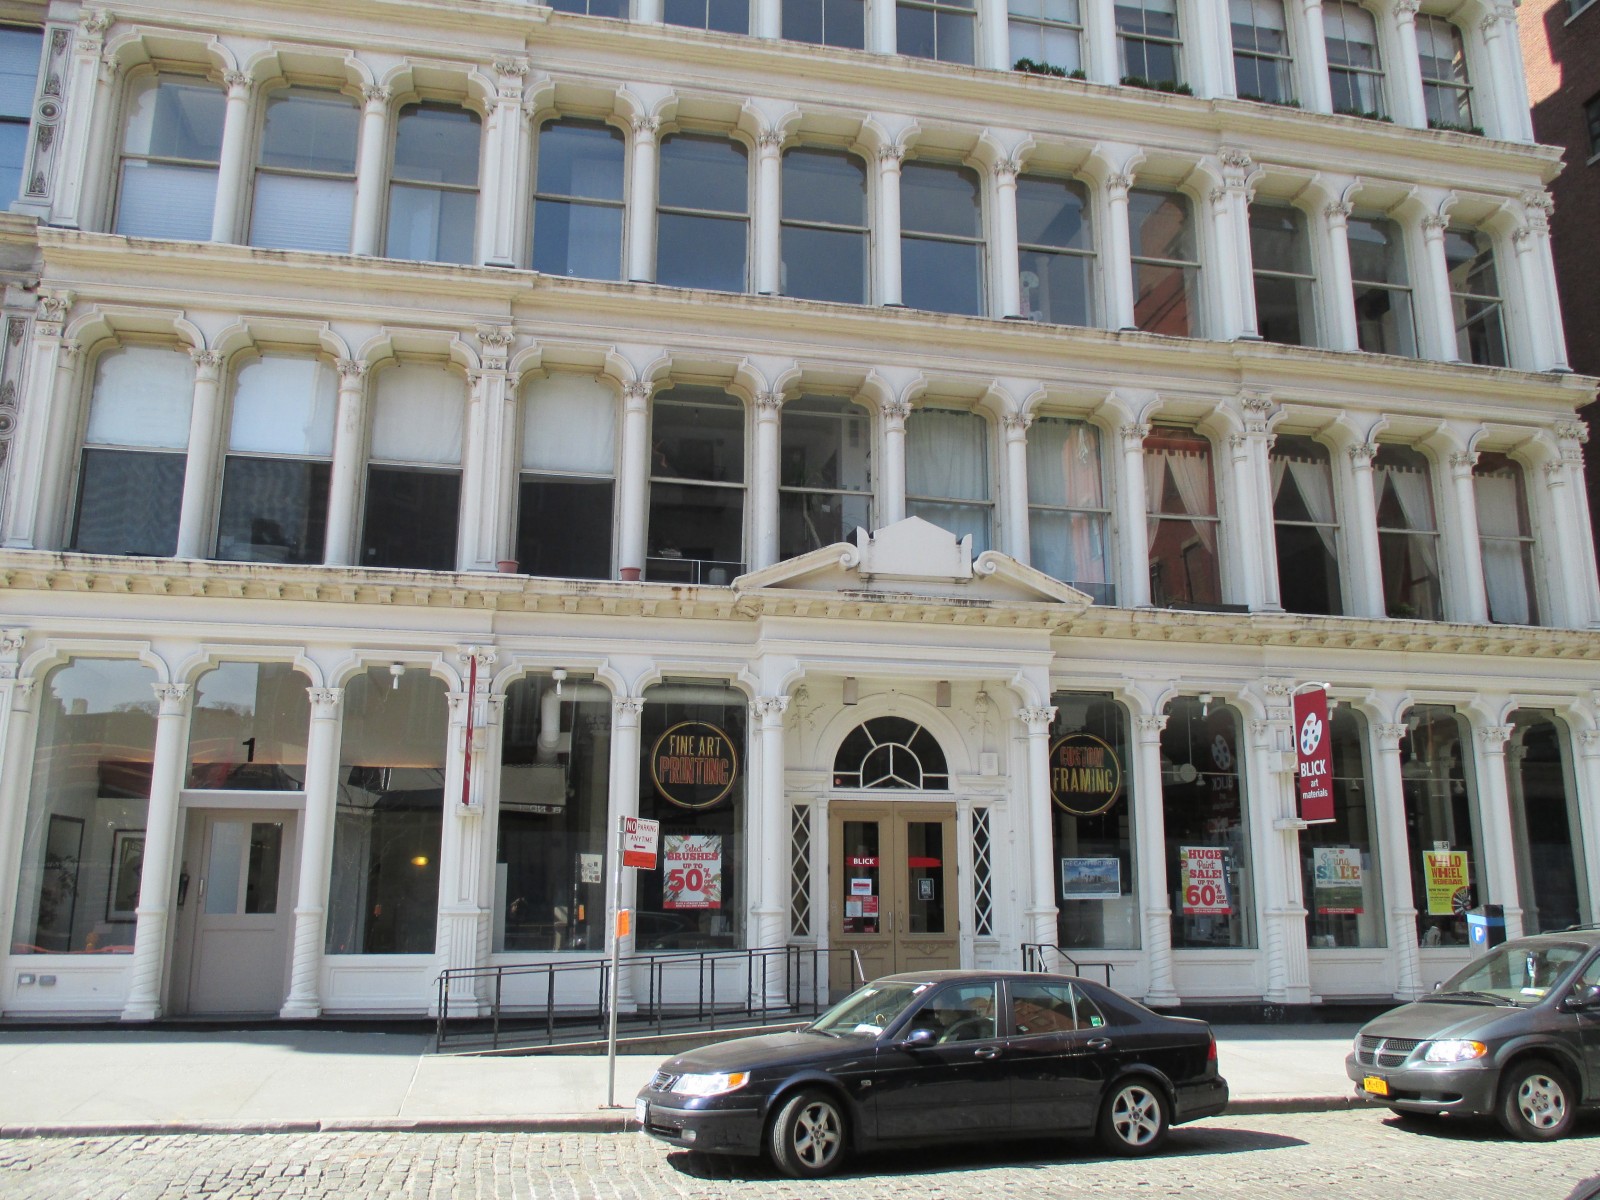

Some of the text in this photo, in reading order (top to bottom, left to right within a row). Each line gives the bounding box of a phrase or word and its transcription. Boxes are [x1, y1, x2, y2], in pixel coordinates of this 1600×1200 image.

[242, 737, 255, 762] 1
[669, 735, 721, 757] FINE ART
[1060, 746, 1104, 767] CUSTOM
[659, 756, 729, 785] PRINTING
[1301, 759, 1326, 777] BLICK
[1053, 767, 1113, 792] FRAMING
[1310, 778, 1319, 788] art
[1302, 788, 1328, 800] materials
[626, 820, 657, 833] NO PARKING
[631, 835, 653, 843] ANYTIME
[685, 844, 703, 852] Select
[667, 852, 719, 861] BRUSHES
[1188, 850, 1221, 860] HUGE
[1197, 860, 1215, 870] Paint
[1189, 870, 1222, 878] SALE!
[1316, 865, 1361, 879] SALE
[1431, 868, 1463, 878] WHEEL
[1475, 926, 1484, 942] P
